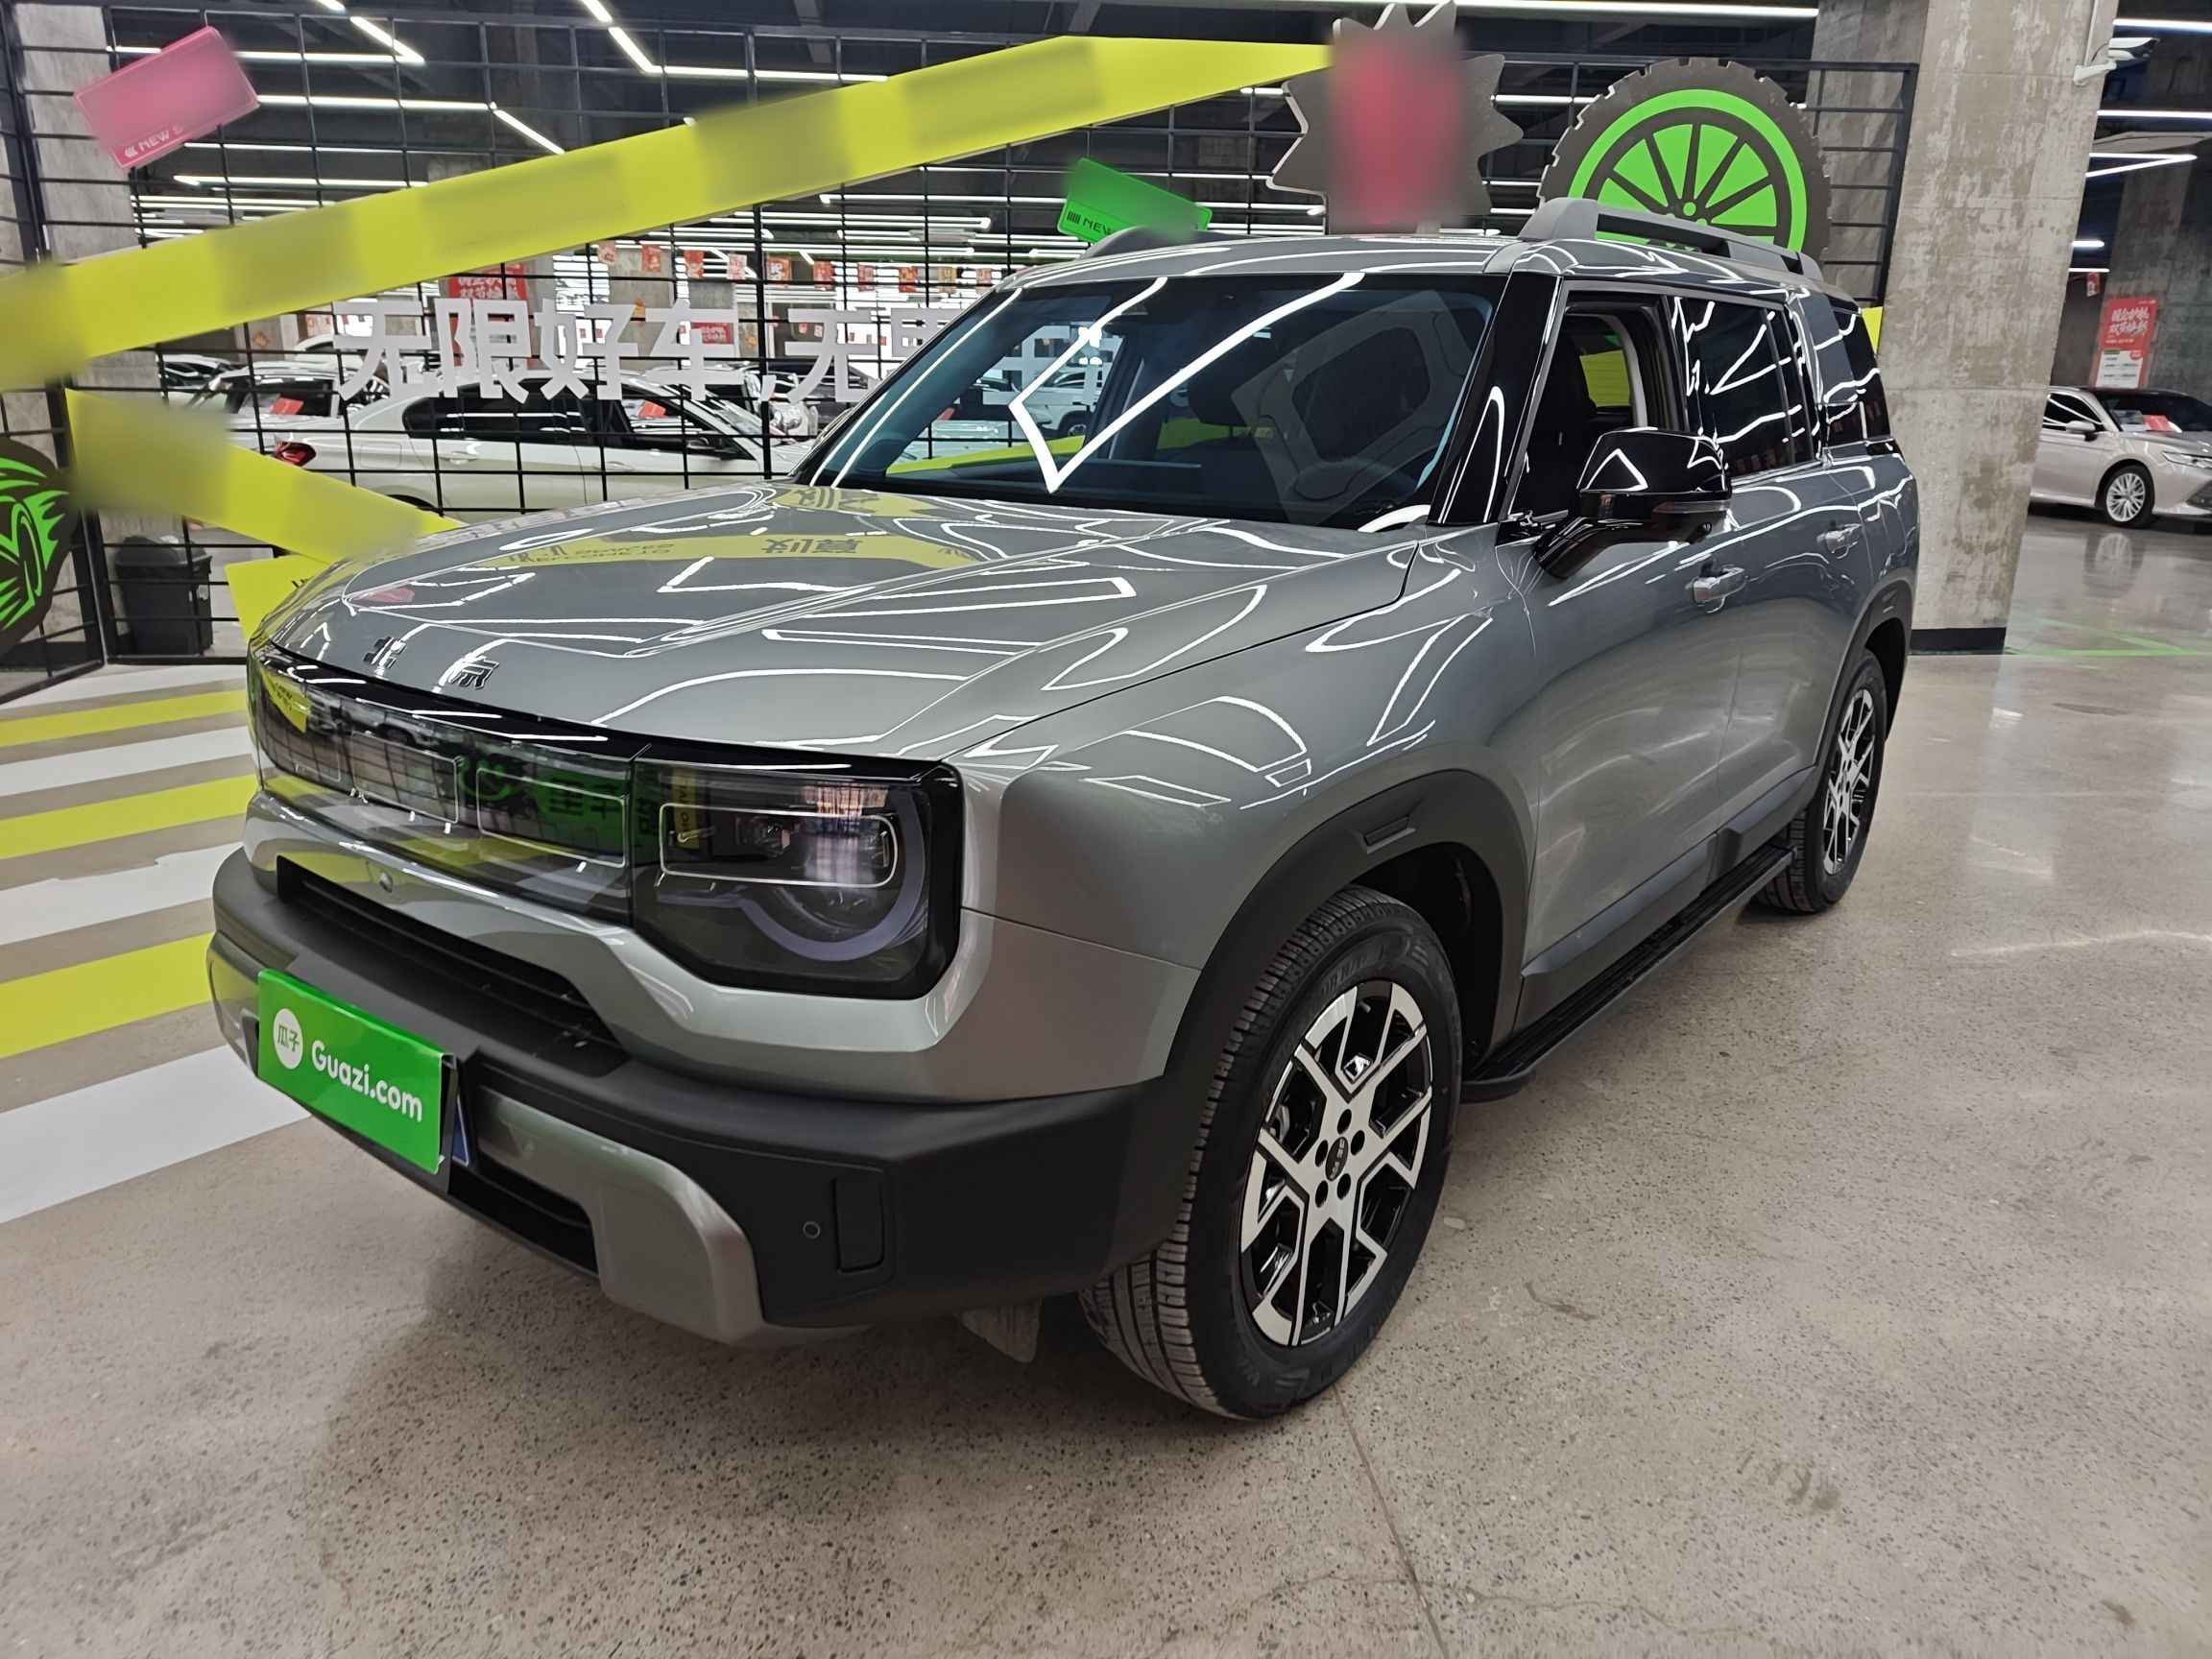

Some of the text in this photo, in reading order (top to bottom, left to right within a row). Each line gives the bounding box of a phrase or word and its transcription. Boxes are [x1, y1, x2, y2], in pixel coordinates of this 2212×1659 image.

[331, 298, 973, 404] 无限好车，无
[276, 1023, 300, 1052] 瓜子
[311, 1040, 422, 1122] Guazi.com
